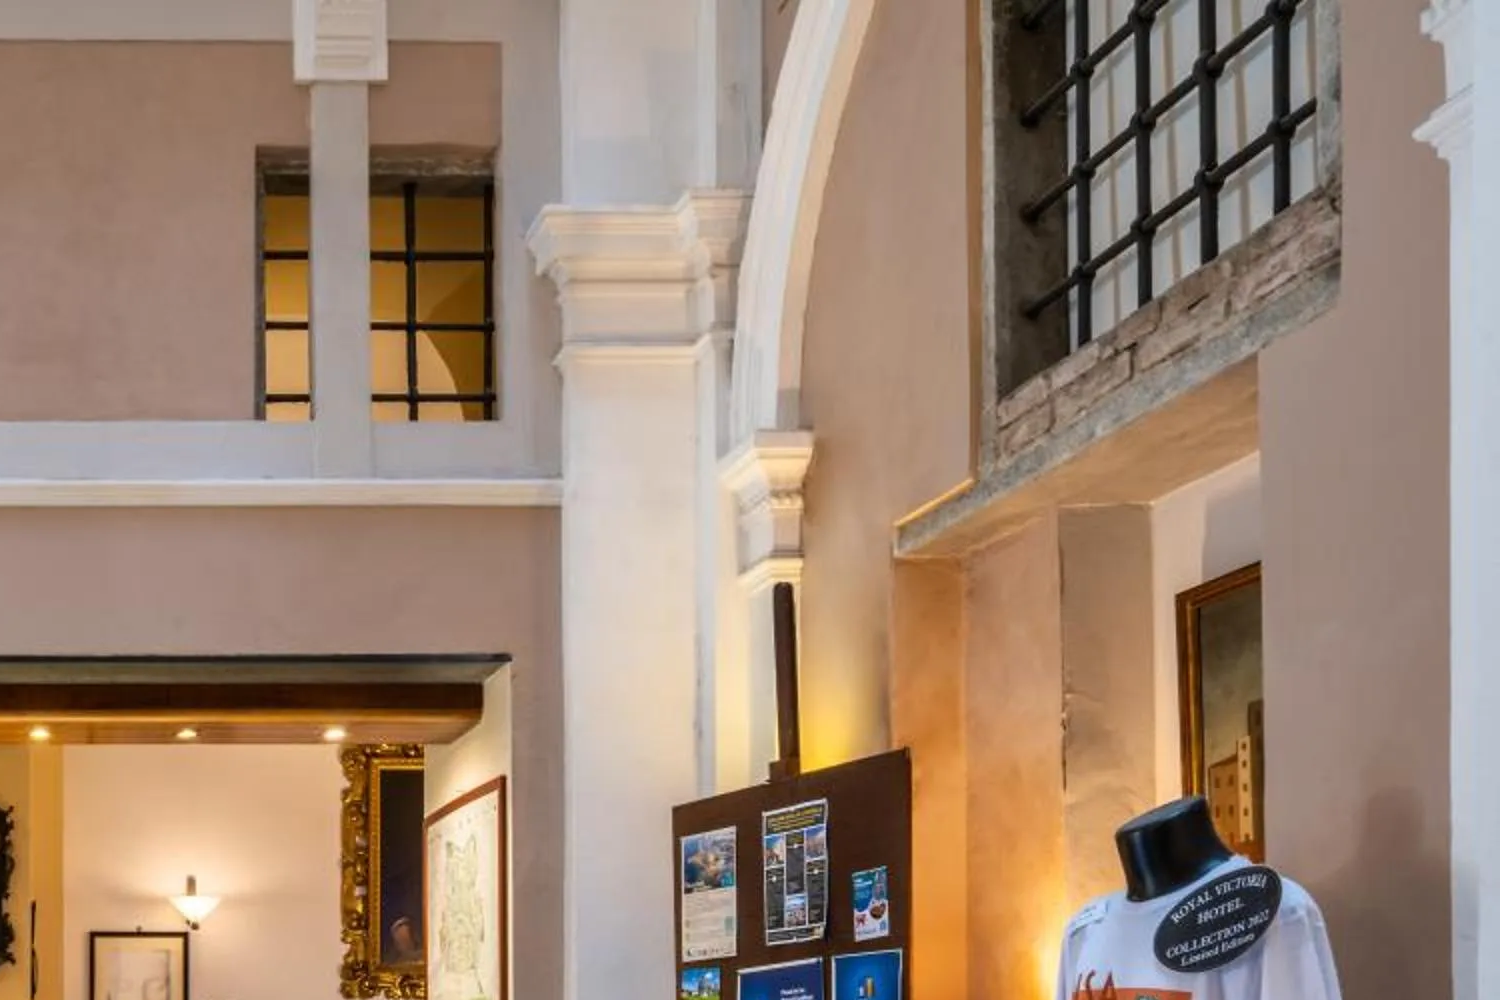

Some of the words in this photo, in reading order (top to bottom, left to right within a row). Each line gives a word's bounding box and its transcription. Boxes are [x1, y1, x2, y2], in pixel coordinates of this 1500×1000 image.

[1171, 890, 1214, 924] ROYAL
[1196, 897, 1243, 924] HOTEL
[1166, 919, 1245, 959] COLLECTION
